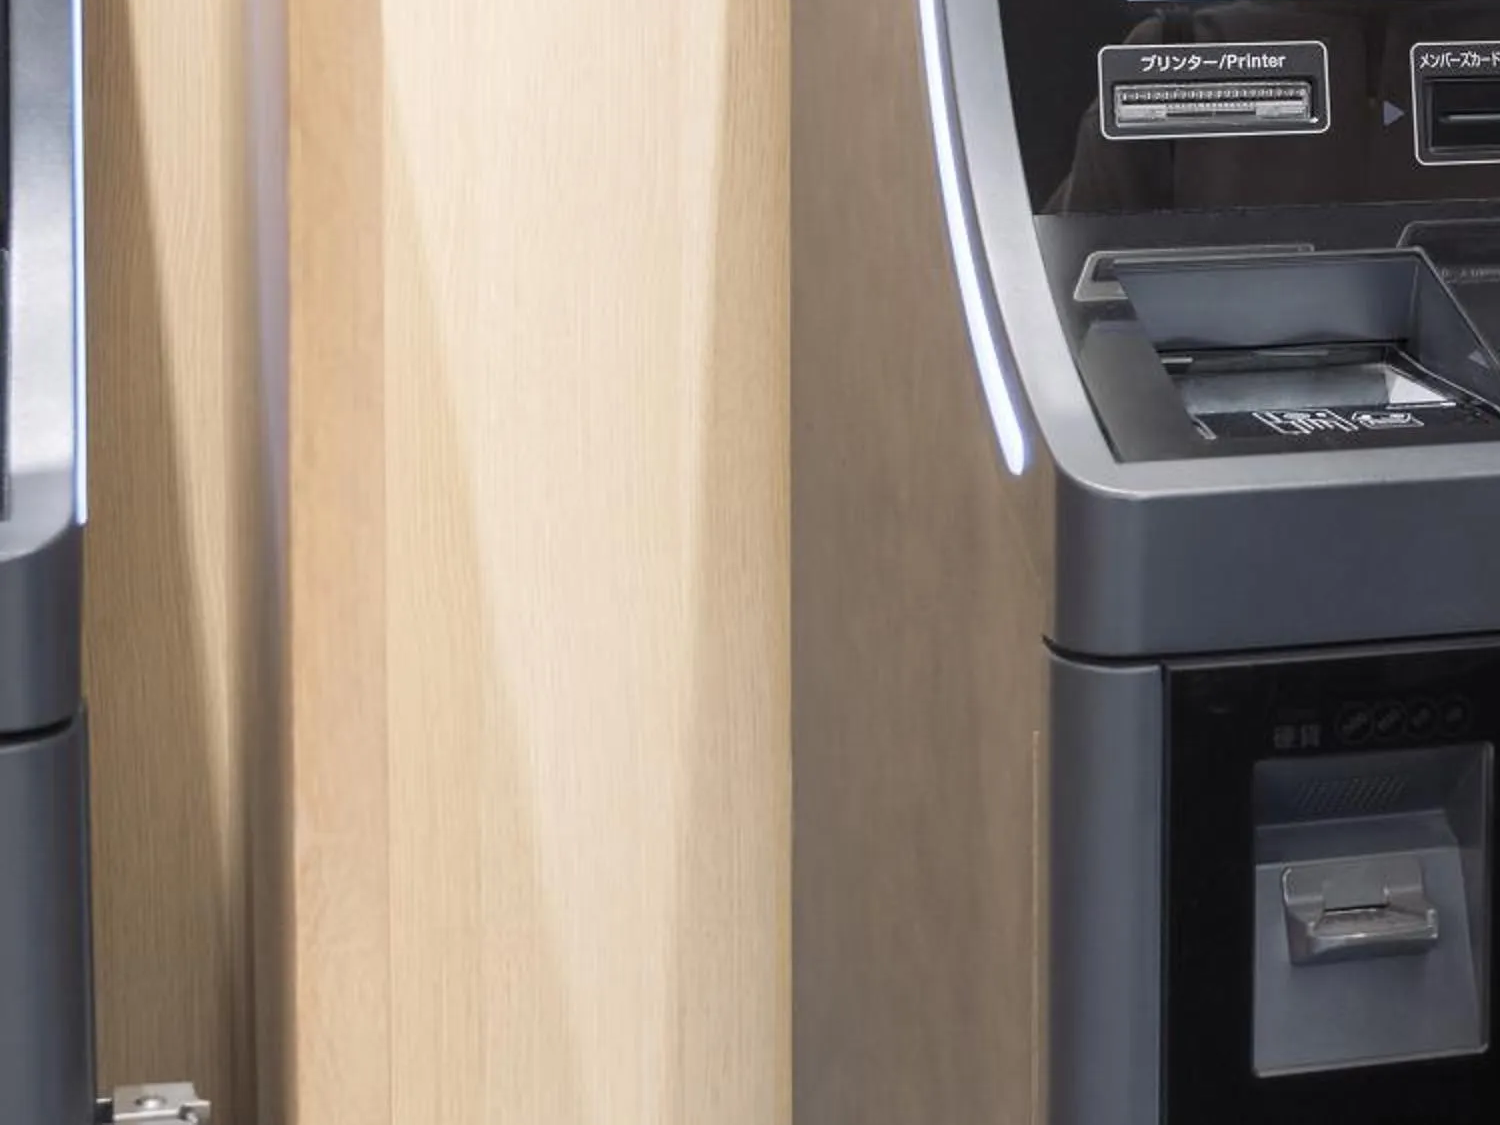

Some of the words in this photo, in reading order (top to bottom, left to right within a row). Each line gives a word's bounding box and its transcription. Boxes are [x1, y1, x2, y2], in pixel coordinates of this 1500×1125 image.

[1140, 53, 1287, 73] プリンター/Printer
